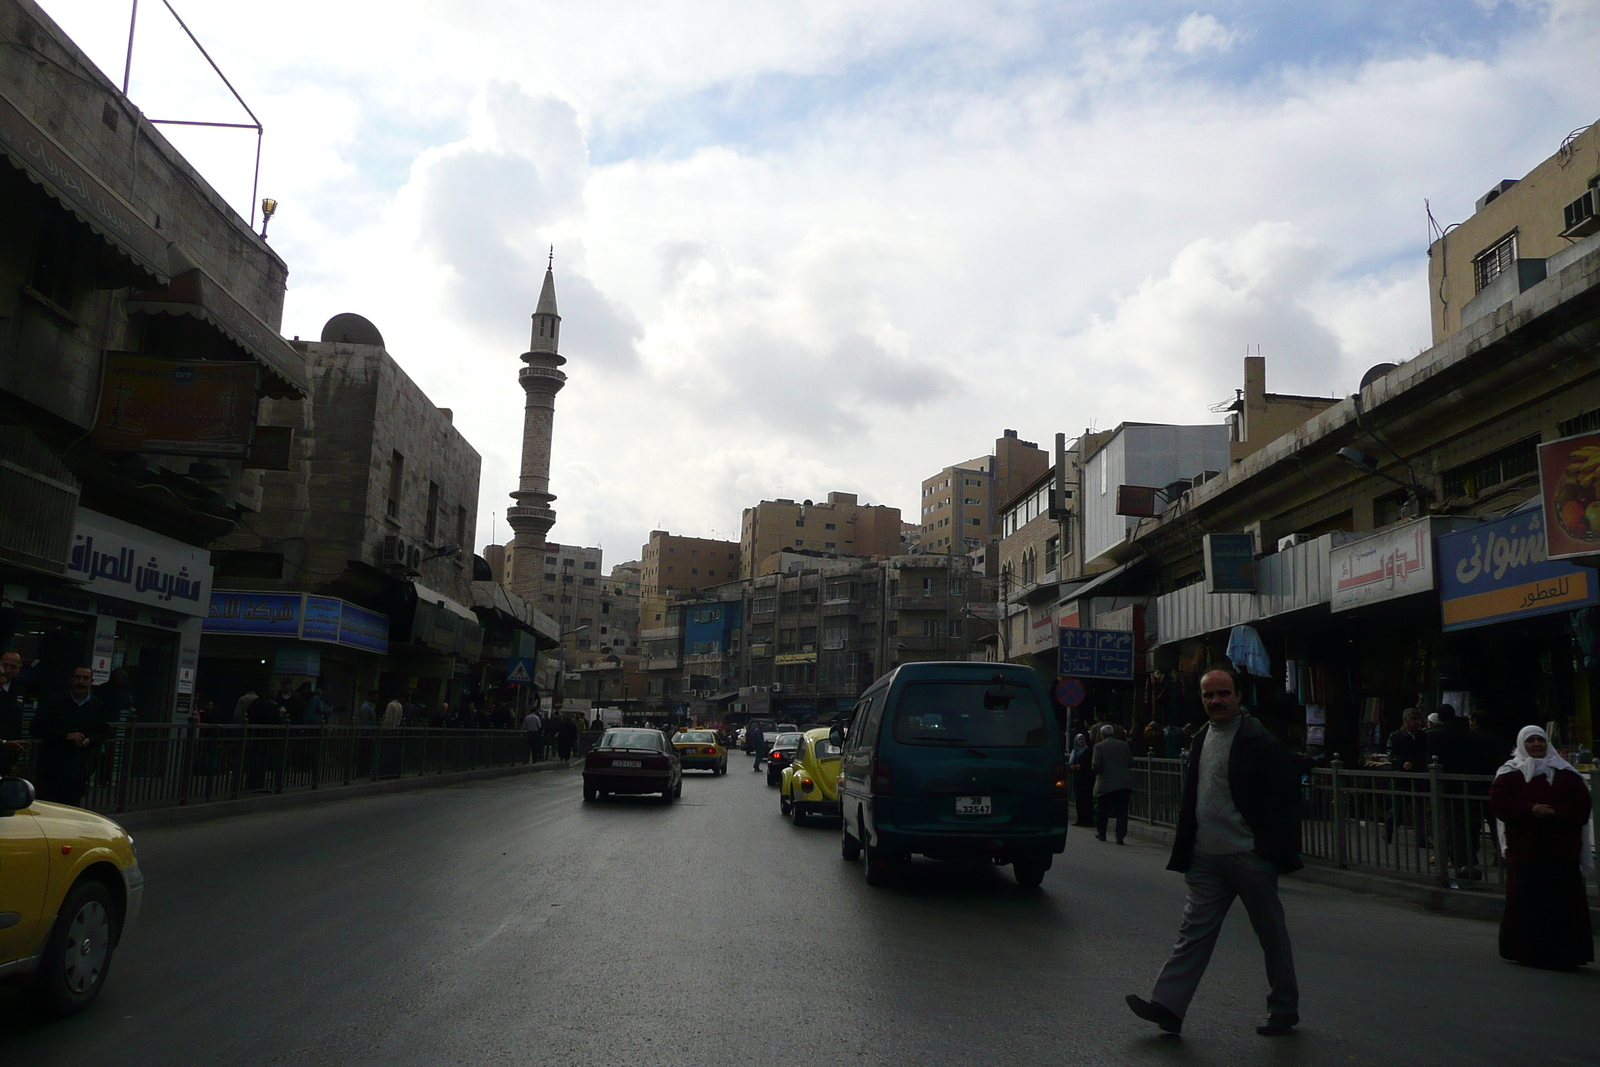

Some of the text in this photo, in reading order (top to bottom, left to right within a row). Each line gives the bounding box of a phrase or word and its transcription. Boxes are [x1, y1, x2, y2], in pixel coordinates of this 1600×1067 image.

[68, 535, 135, 584] للصراف
[136, 557, 202, 601] مشربش
[1520, 577, 1569, 608] للعطور
[208, 598, 242, 619] الاخ
[244, 600, 294, 624] شركة
[1063, 651, 1091, 662] شارع
[1101, 652, 1129, 663] ساحة
[1063, 662, 1091, 673] طلال
[1100, 664, 1128, 676] فيصل
[962, 805, 990, 813] 32547
